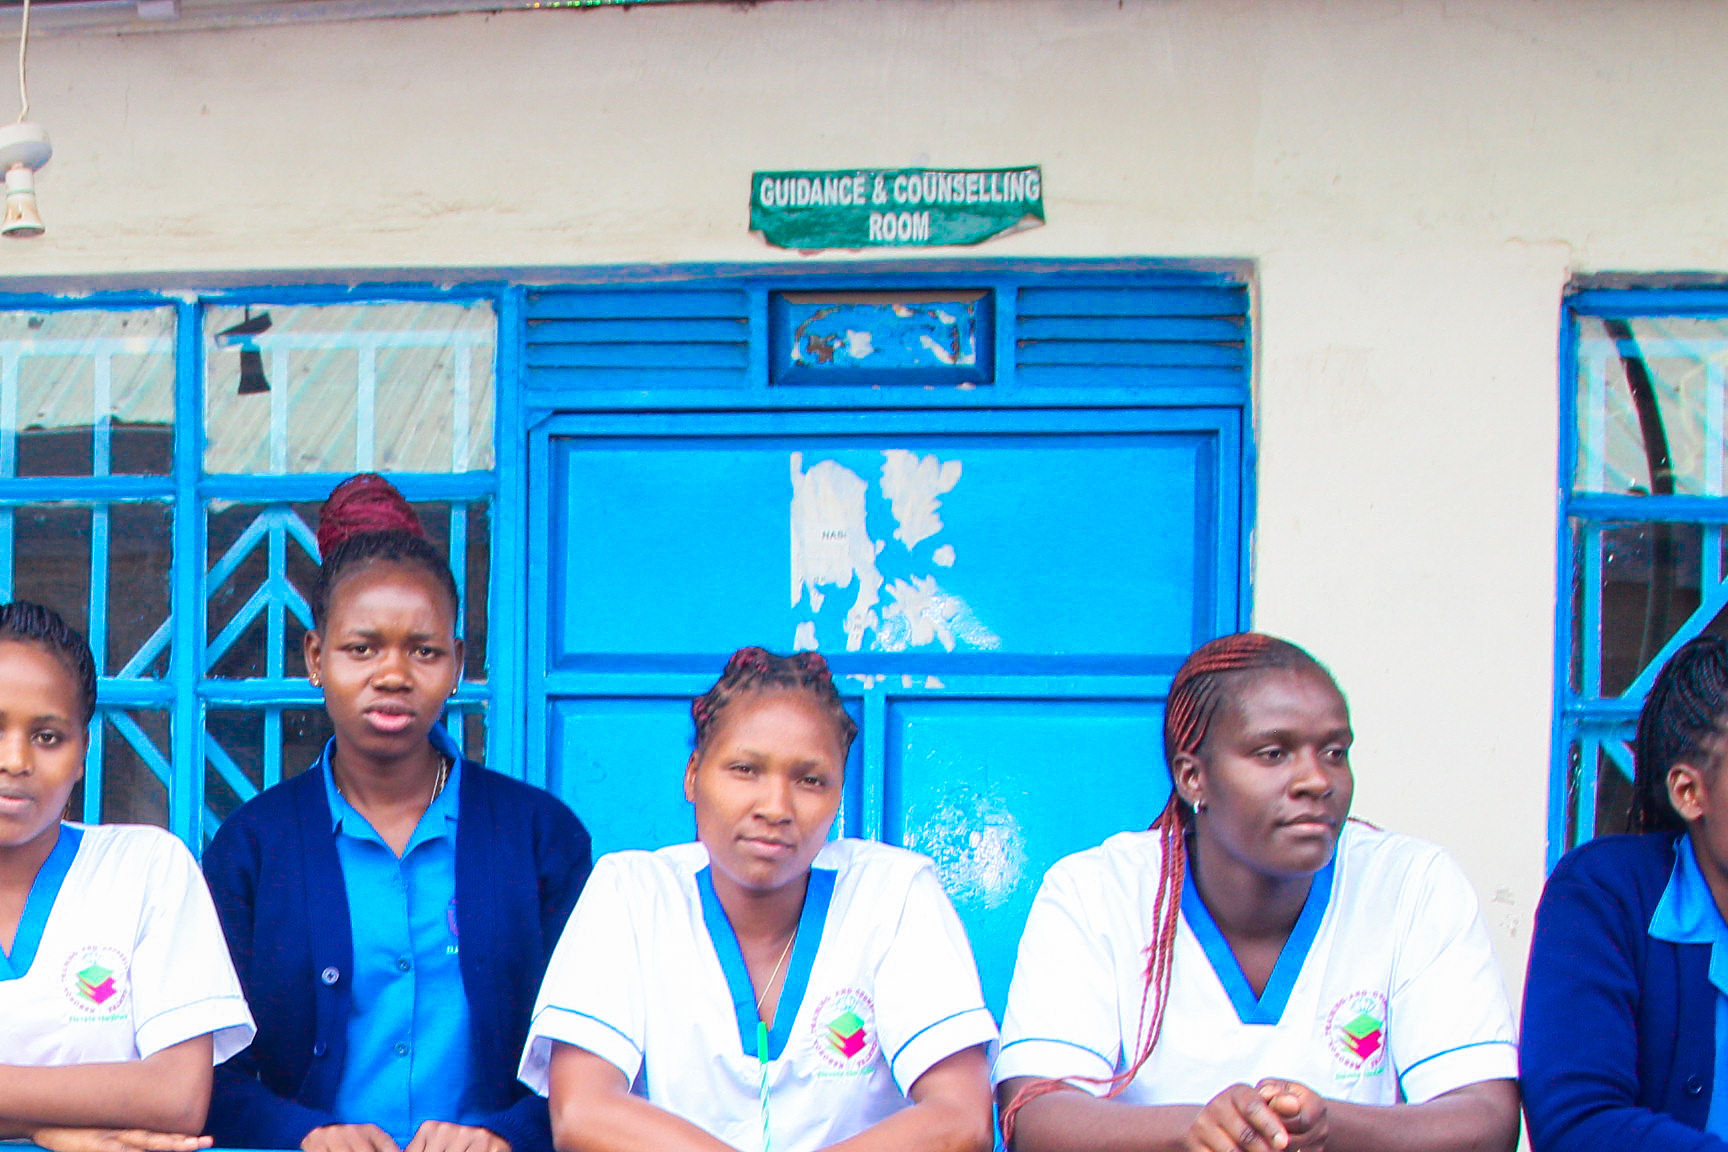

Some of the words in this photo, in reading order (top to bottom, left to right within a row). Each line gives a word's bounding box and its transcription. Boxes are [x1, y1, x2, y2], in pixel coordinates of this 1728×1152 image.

[760, 175, 866, 207] GUIDANCE
[873, 174, 888, 205] &
[893, 172, 1040, 204] COUNSELLING
[869, 210, 930, 241] ROOM
